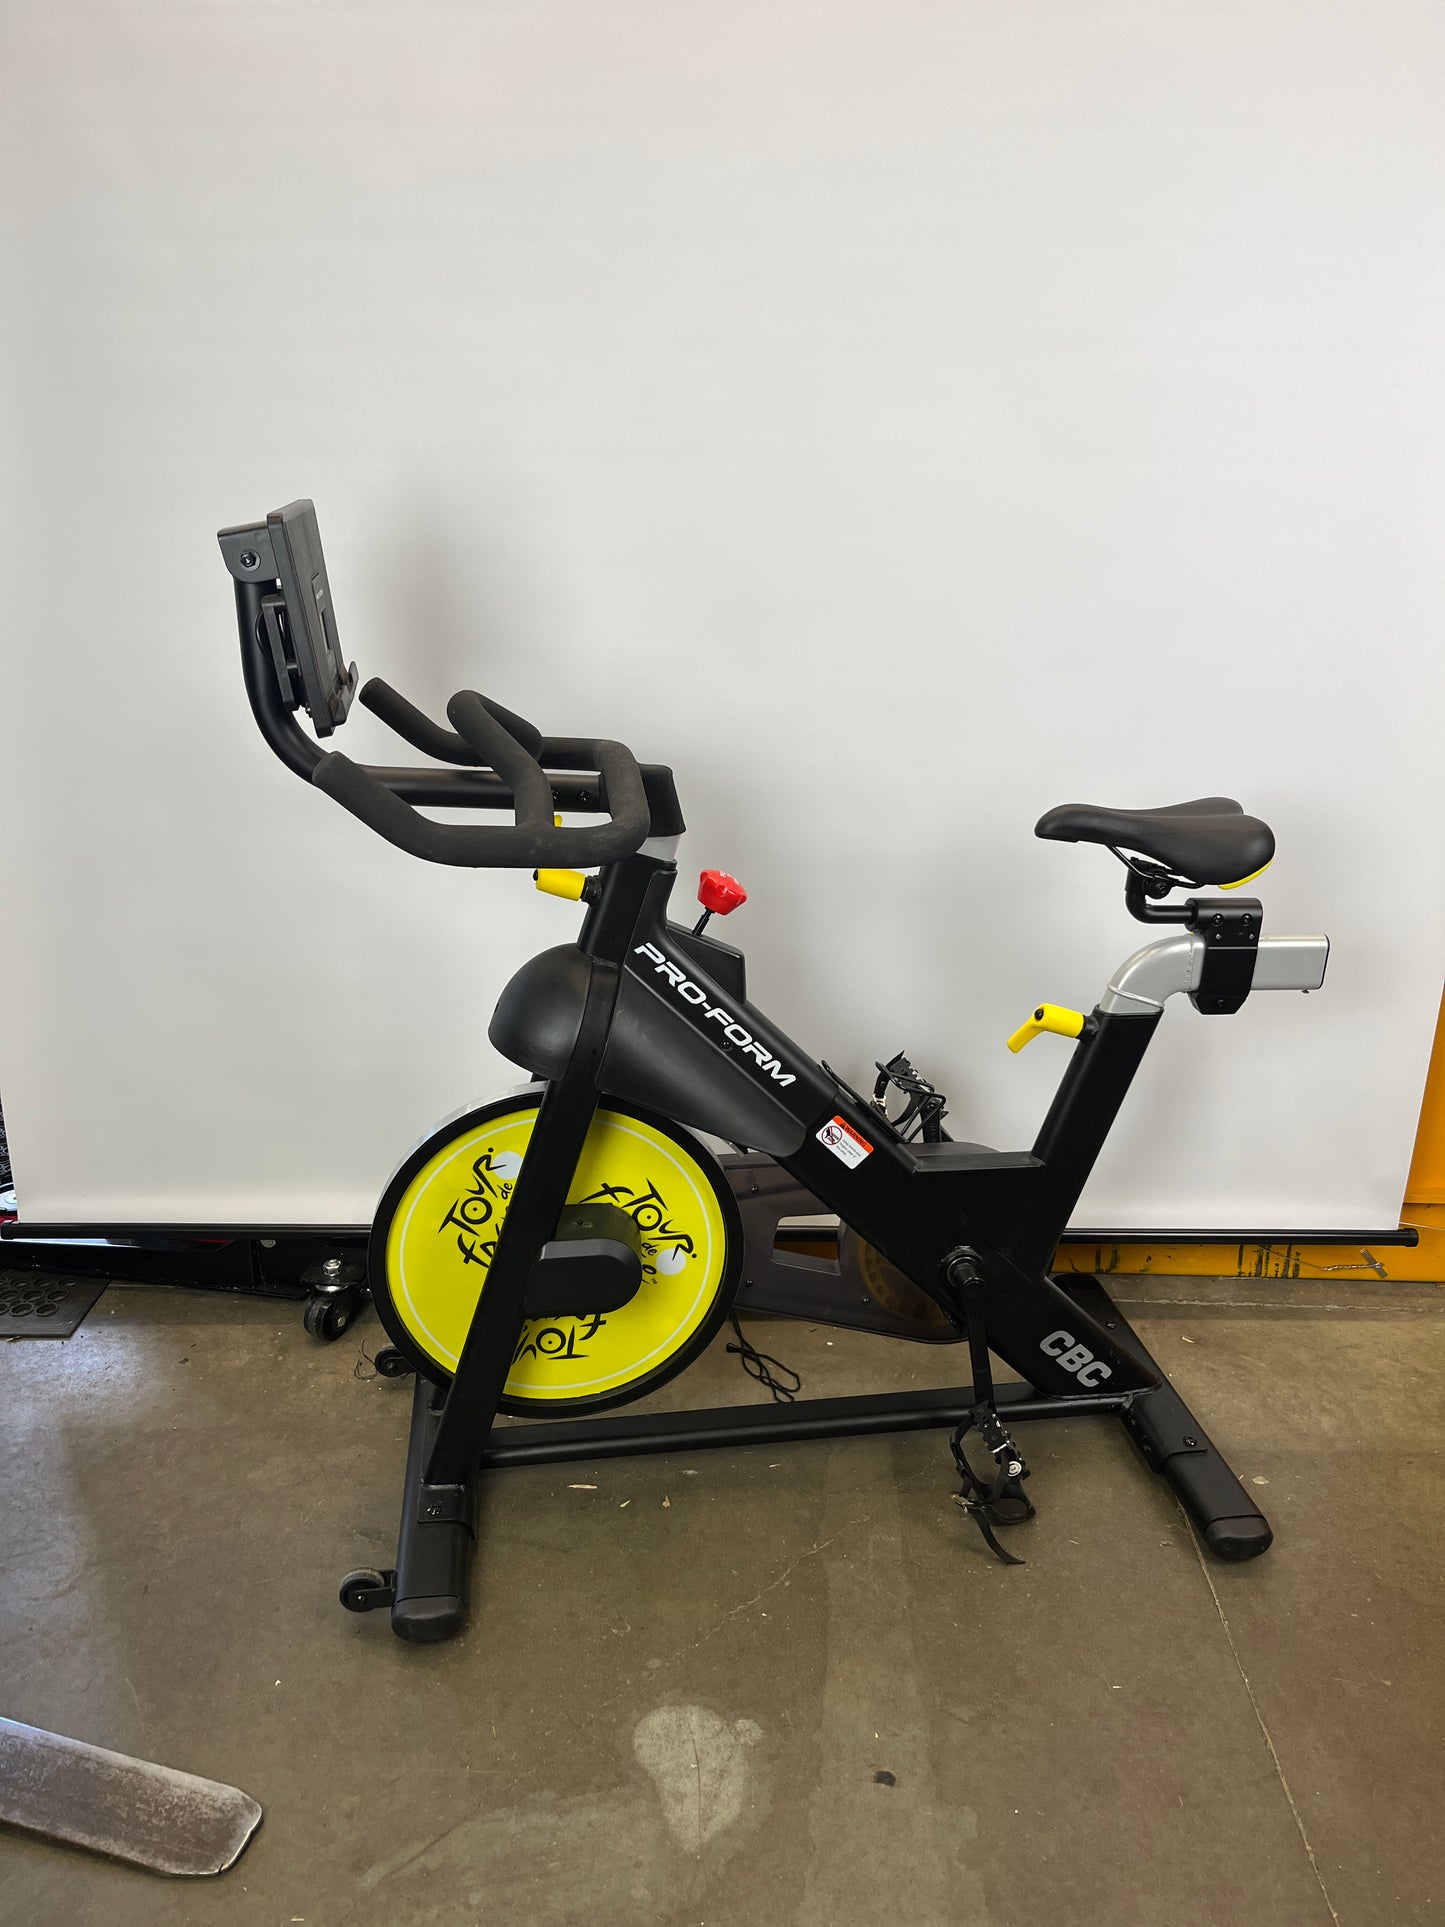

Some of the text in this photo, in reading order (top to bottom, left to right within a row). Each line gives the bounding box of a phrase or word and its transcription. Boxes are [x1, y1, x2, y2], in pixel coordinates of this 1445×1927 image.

[634, 942, 797, 1088] PRO-FORM
[844, 1125, 867, 1148] WARNING
[497, 1183, 513, 1200] de
[641, 1242, 660, 1256] de
[1040, 1330, 1112, 1388] CBC
